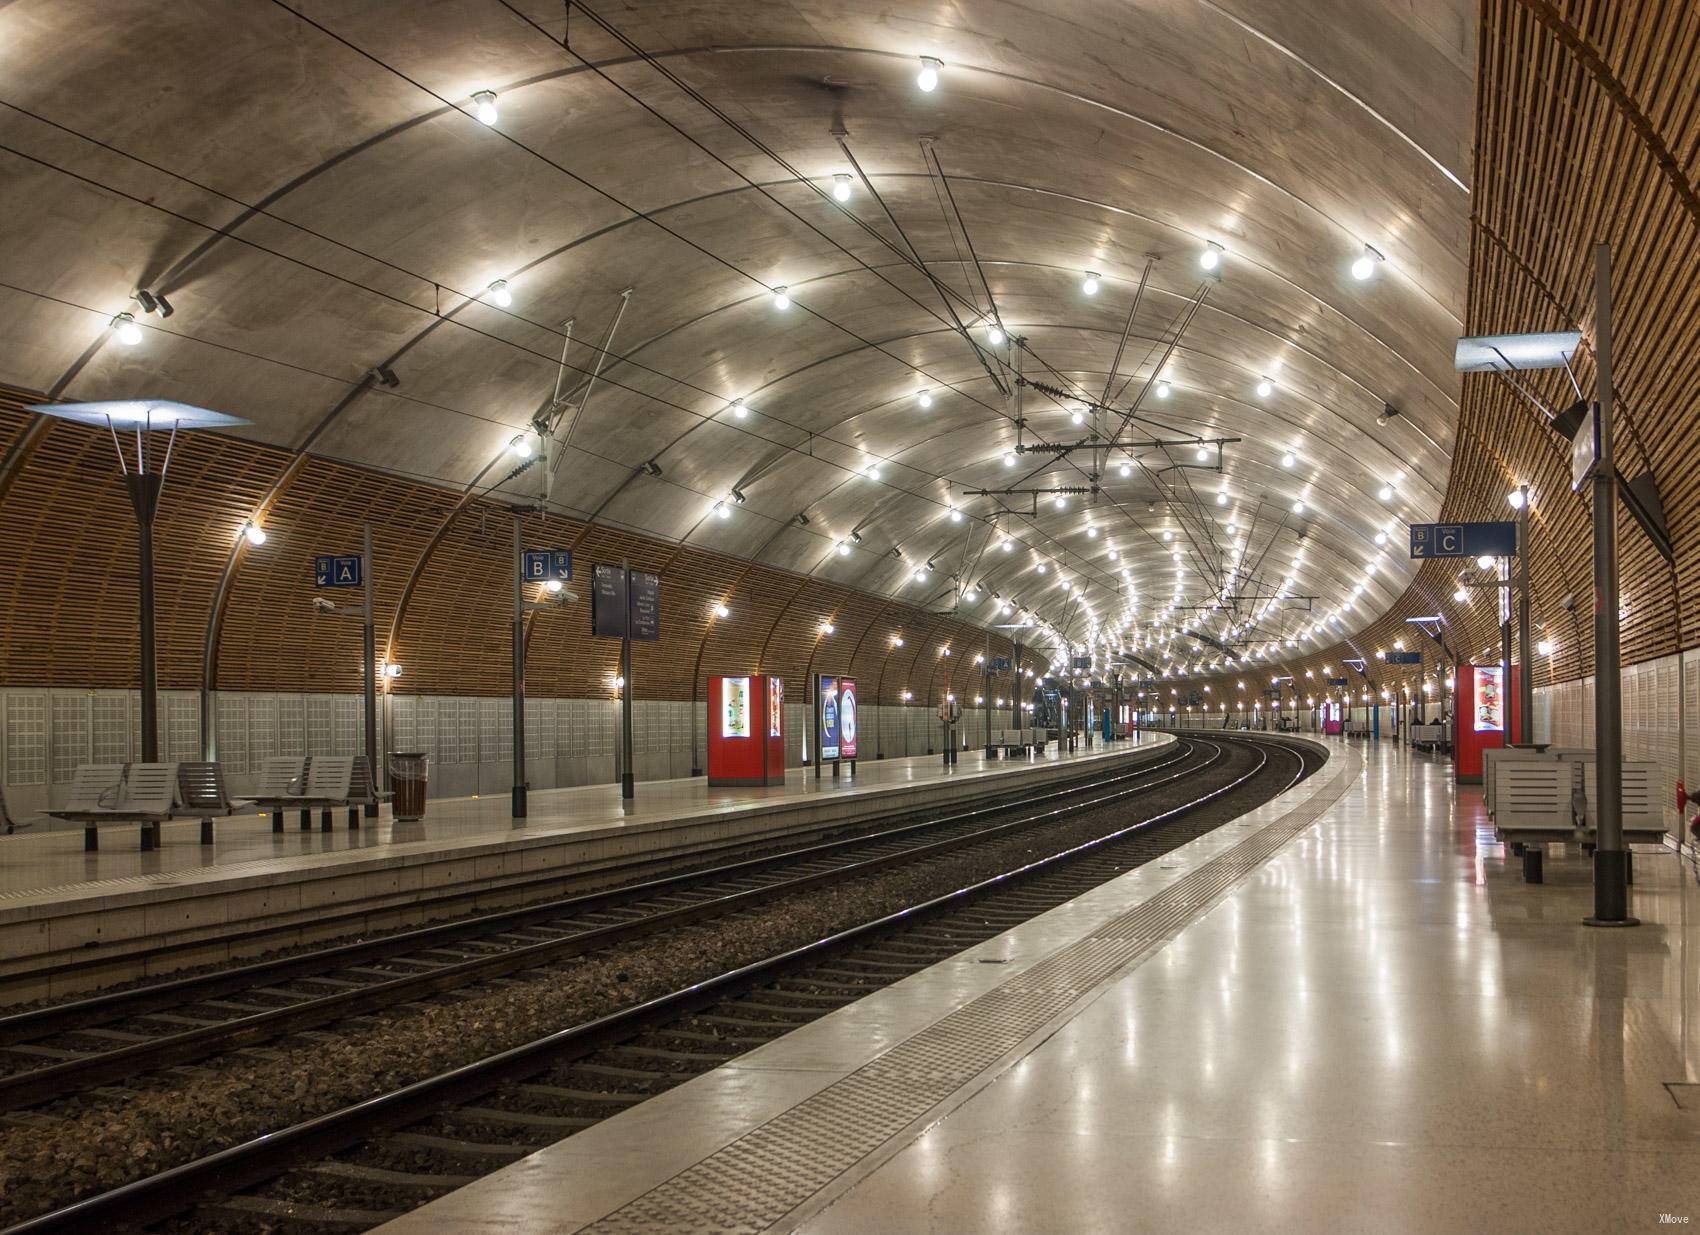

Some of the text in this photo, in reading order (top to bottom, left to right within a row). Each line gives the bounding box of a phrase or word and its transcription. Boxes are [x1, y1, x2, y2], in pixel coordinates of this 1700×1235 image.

[1417, 531, 1425, 540] B
[1443, 535, 1455, 551] C
[340, 566, 352, 580] A
[533, 561, 543, 575] B
